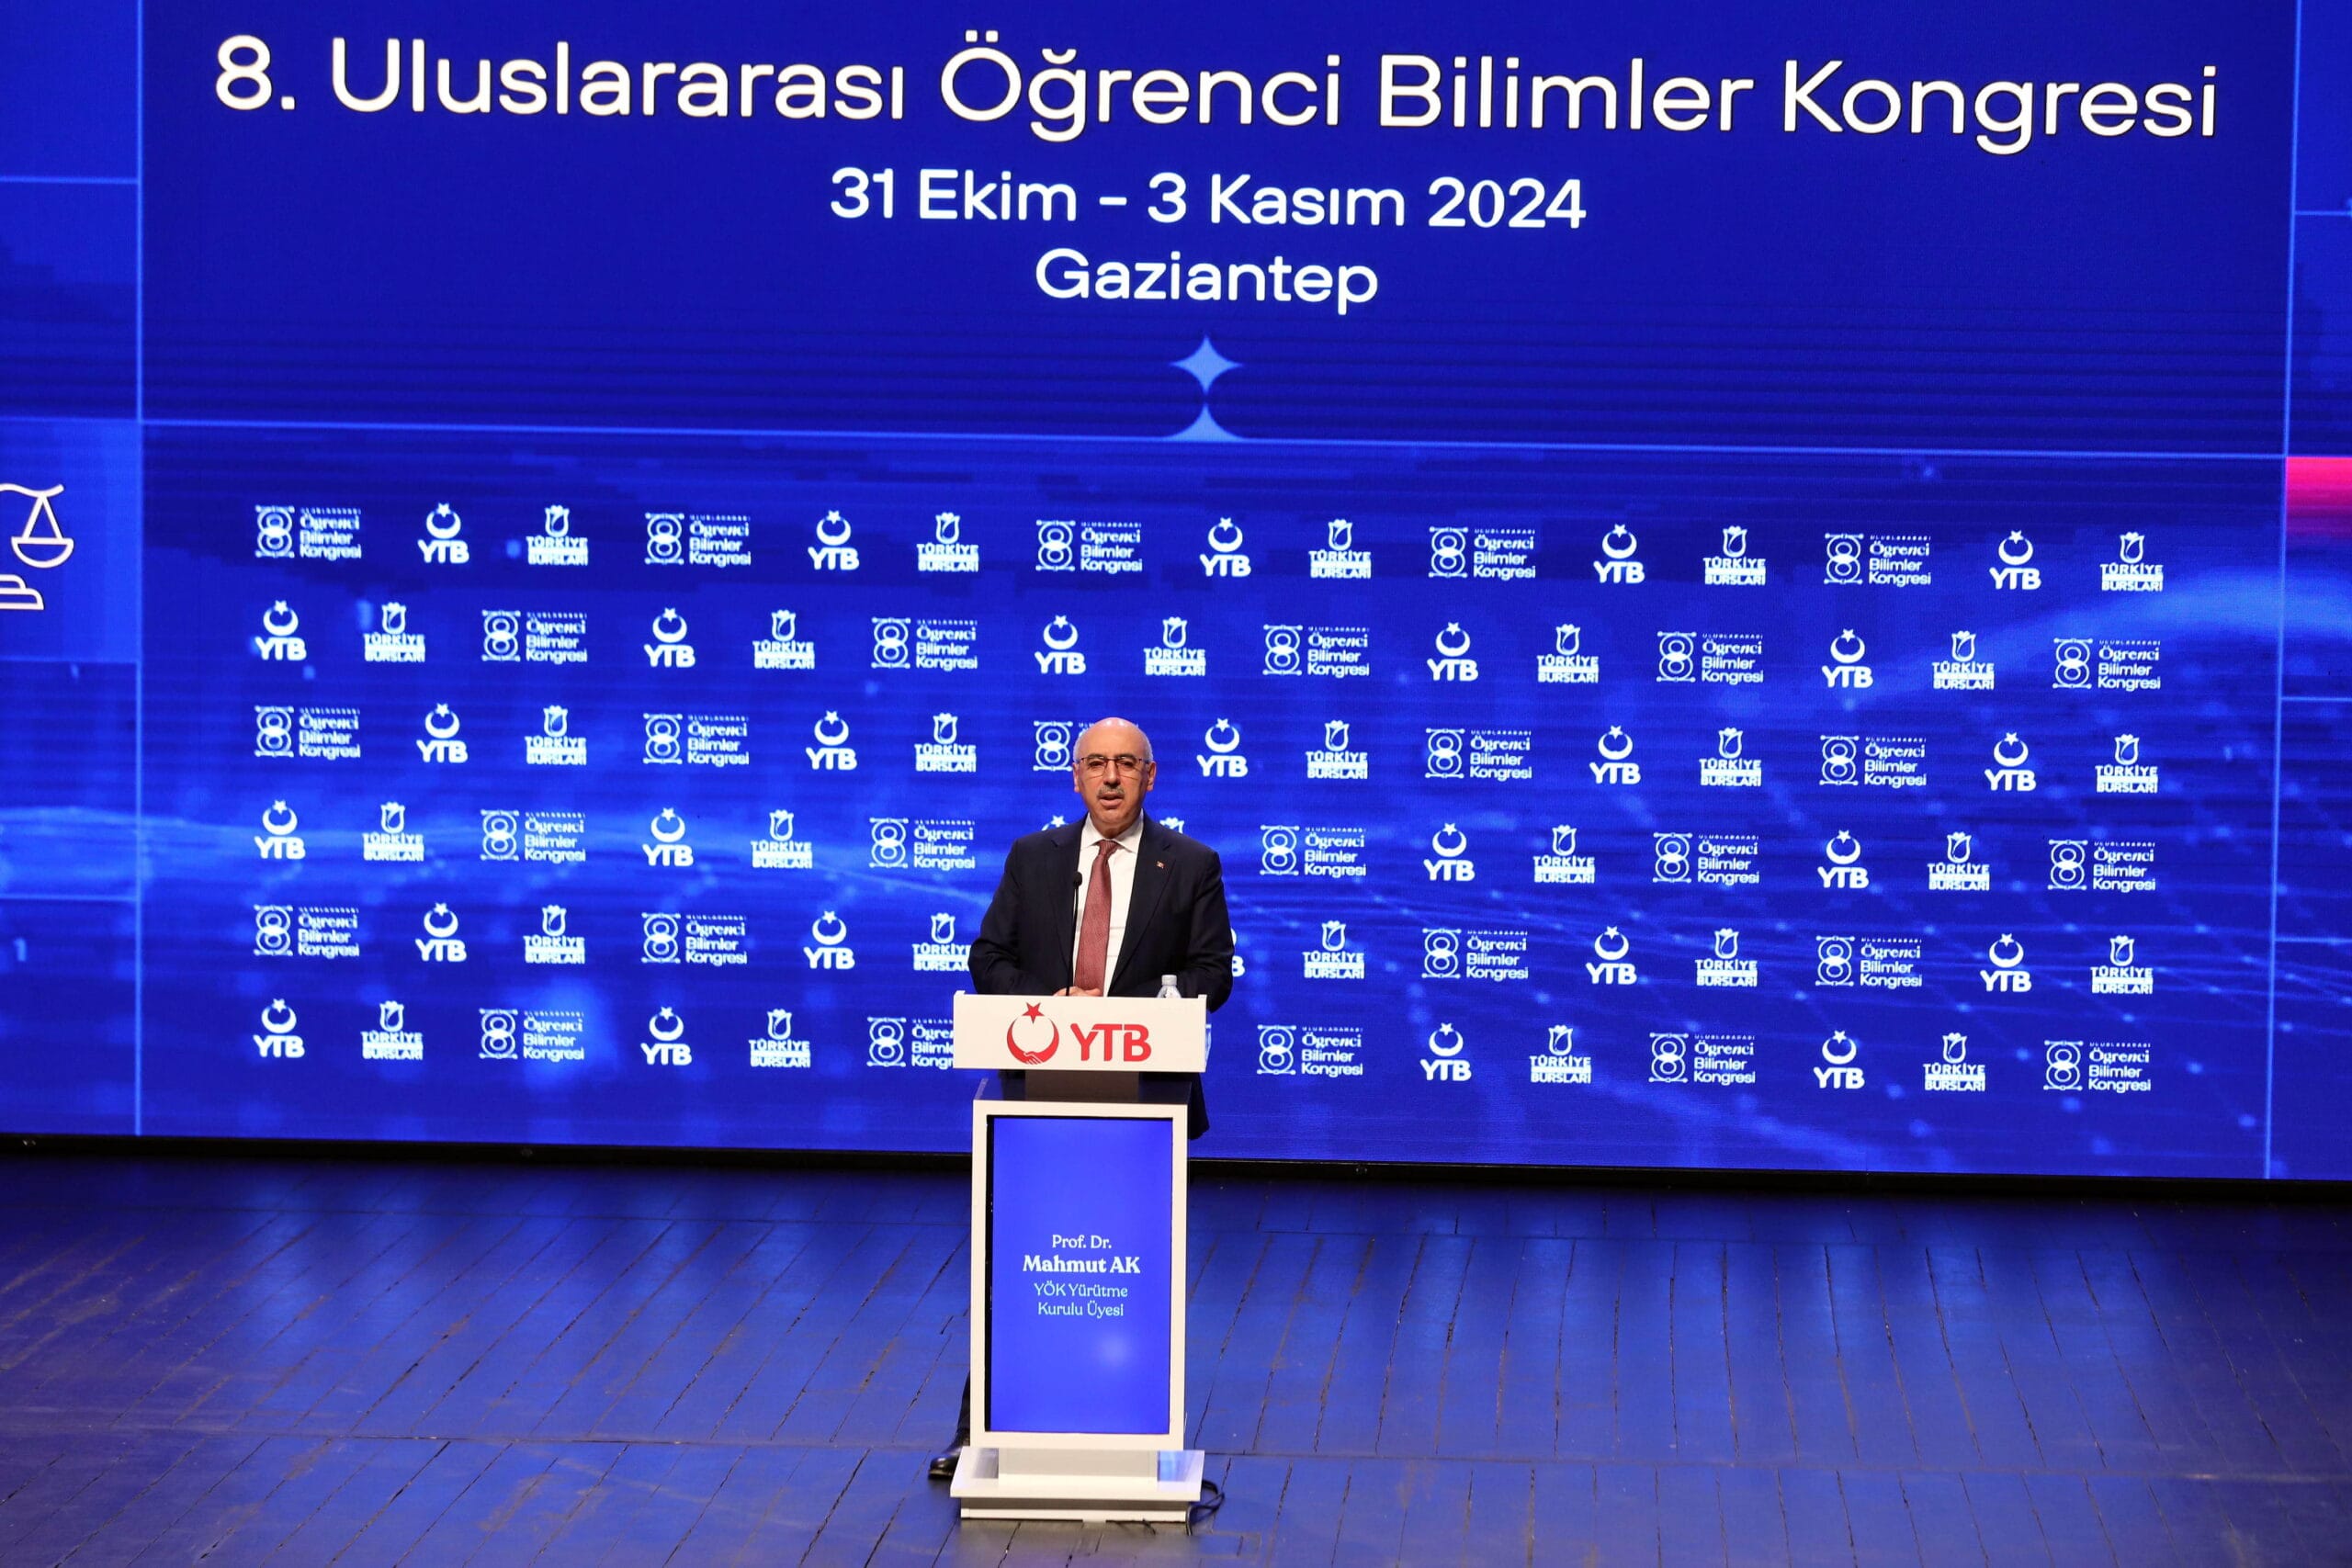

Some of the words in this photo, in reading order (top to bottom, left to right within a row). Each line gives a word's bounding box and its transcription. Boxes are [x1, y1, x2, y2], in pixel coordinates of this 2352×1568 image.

[216, 35, 295, 109] 8.
[333, 38, 903, 119] Uluslararası
[942, 30, 1340, 141] Öğrenci
[1381, 55, 1754, 130] Bilimler
[1784, 61, 2215, 154] Kongresi
[831, 167, 893, 218] 31
[920, 169, 1076, 220] Ekim
[1148, 173, 1186, 222] 3
[1212, 174, 1404, 226] Kasım
[1429, 176, 1586, 228] 2024
[1036, 248, 1377, 315] Gaziantep
[418, 540, 469, 563] YTB
[808, 547, 859, 570] YTB
[1080, 558, 1142, 574] Kongresi
[1200, 554, 1251, 577] YTB
[1474, 565, 1535, 581] Kongresi
[1594, 560, 1645, 583] YTB
[1869, 571, 1931, 587] Kongresi
[1989, 567, 2041, 590] YTB
[254, 637, 306, 660] YTB
[644, 644, 695, 667] YTB
[1035, 651, 1086, 674] YTB
[1307, 662, 1369, 678] Kongresi
[1427, 658, 1478, 681] YTB
[1702, 670, 1763, 685] Kongresi
[1822, 665, 1873, 688] YTB
[2098, 676, 2160, 692] Kongresi
[416, 740, 468, 763] YTB
[806, 747, 857, 770] YTB
[1197, 754, 1248, 777] YTB
[1470, 765, 1532, 781] Kongresi
[1589, 761, 1641, 784] YTB
[1864, 773, 1927, 788] Kongresi
[1984, 768, 2036, 791] YTB
[254, 837, 306, 860] YTB
[642, 843, 694, 866] YTB
[1305, 863, 1366, 879] Kongresi
[1423, 858, 1475, 881] YTB
[1698, 871, 1759, 886] Kongresi
[1817, 865, 1869, 888] YTB
[2093, 877, 2155, 893] Kongresi
[415, 939, 467, 962] YTB
[804, 946, 854, 969] YTB
[1466, 965, 1528, 981] Kongresi
[1586, 962, 1637, 985] YTB
[1860, 974, 1922, 989] Kongresi
[1980, 969, 2031, 992] YTB
[254, 1034, 305, 1057] YTB
[1069, 1023, 1151, 1062] YTB
[641, 1043, 692, 1066] YTB
[1301, 1062, 1363, 1077] Kongresi
[1420, 1058, 1471, 1081] YTB
[1693, 1070, 1755, 1086] Kongresi
[1814, 1066, 1864, 1089] YTB
[2088, 1077, 2151, 1093] Kongresi
[1052, 1235, 1087, 1248] Prof.
[1091, 1235, 1112, 1248] Dr.
[1023, 1255, 1106, 1272] Mahmut
[1110, 1257, 1140, 1273] AK
[1034, 1280, 1066, 1296] YÖK
[1069, 1283, 1128, 1297] Yürütme
[1038, 1302, 1083, 1315] Kurulu
[1088, 1301, 1124, 1319] Üyesi
